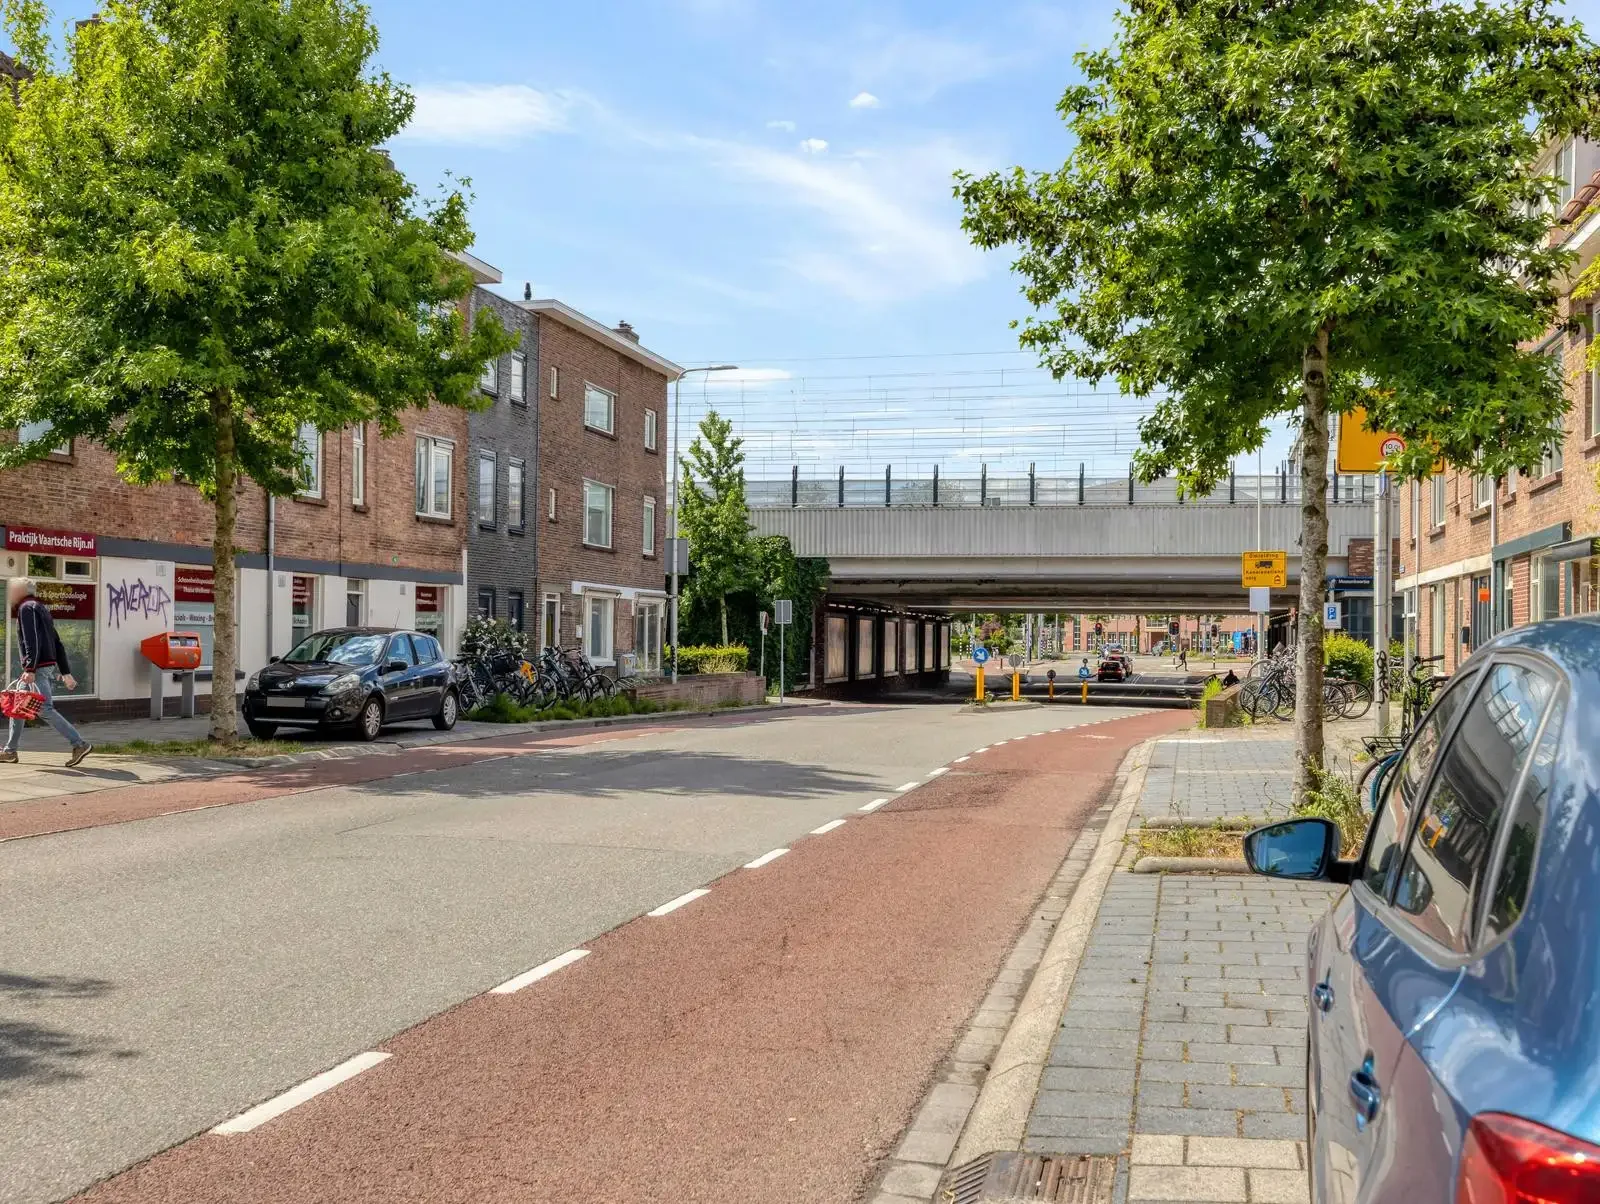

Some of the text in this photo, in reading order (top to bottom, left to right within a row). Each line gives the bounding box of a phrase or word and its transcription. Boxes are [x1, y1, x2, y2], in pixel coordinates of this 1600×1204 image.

[9, 530, 94, 551] Praktijk Vaartsche Rijn.nl
